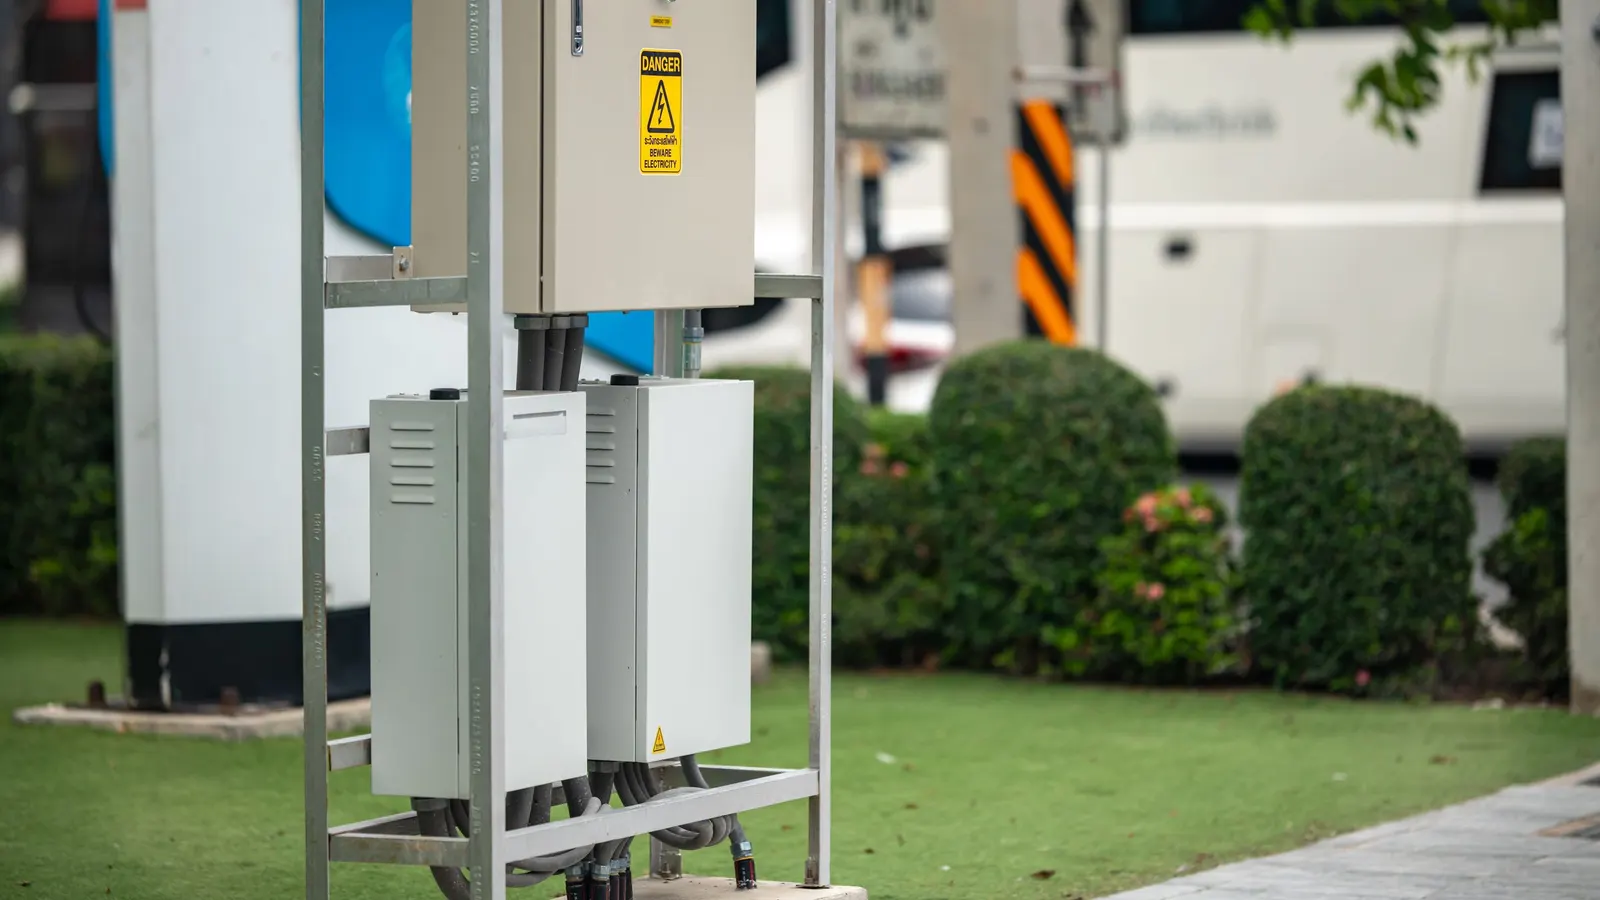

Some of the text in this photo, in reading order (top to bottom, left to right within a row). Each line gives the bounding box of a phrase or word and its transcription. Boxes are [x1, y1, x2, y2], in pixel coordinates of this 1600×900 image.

[642, 55, 680, 72] DANGER
[650, 148, 672, 157] BEWARE
[644, 159, 677, 168] ELECTRICITY
